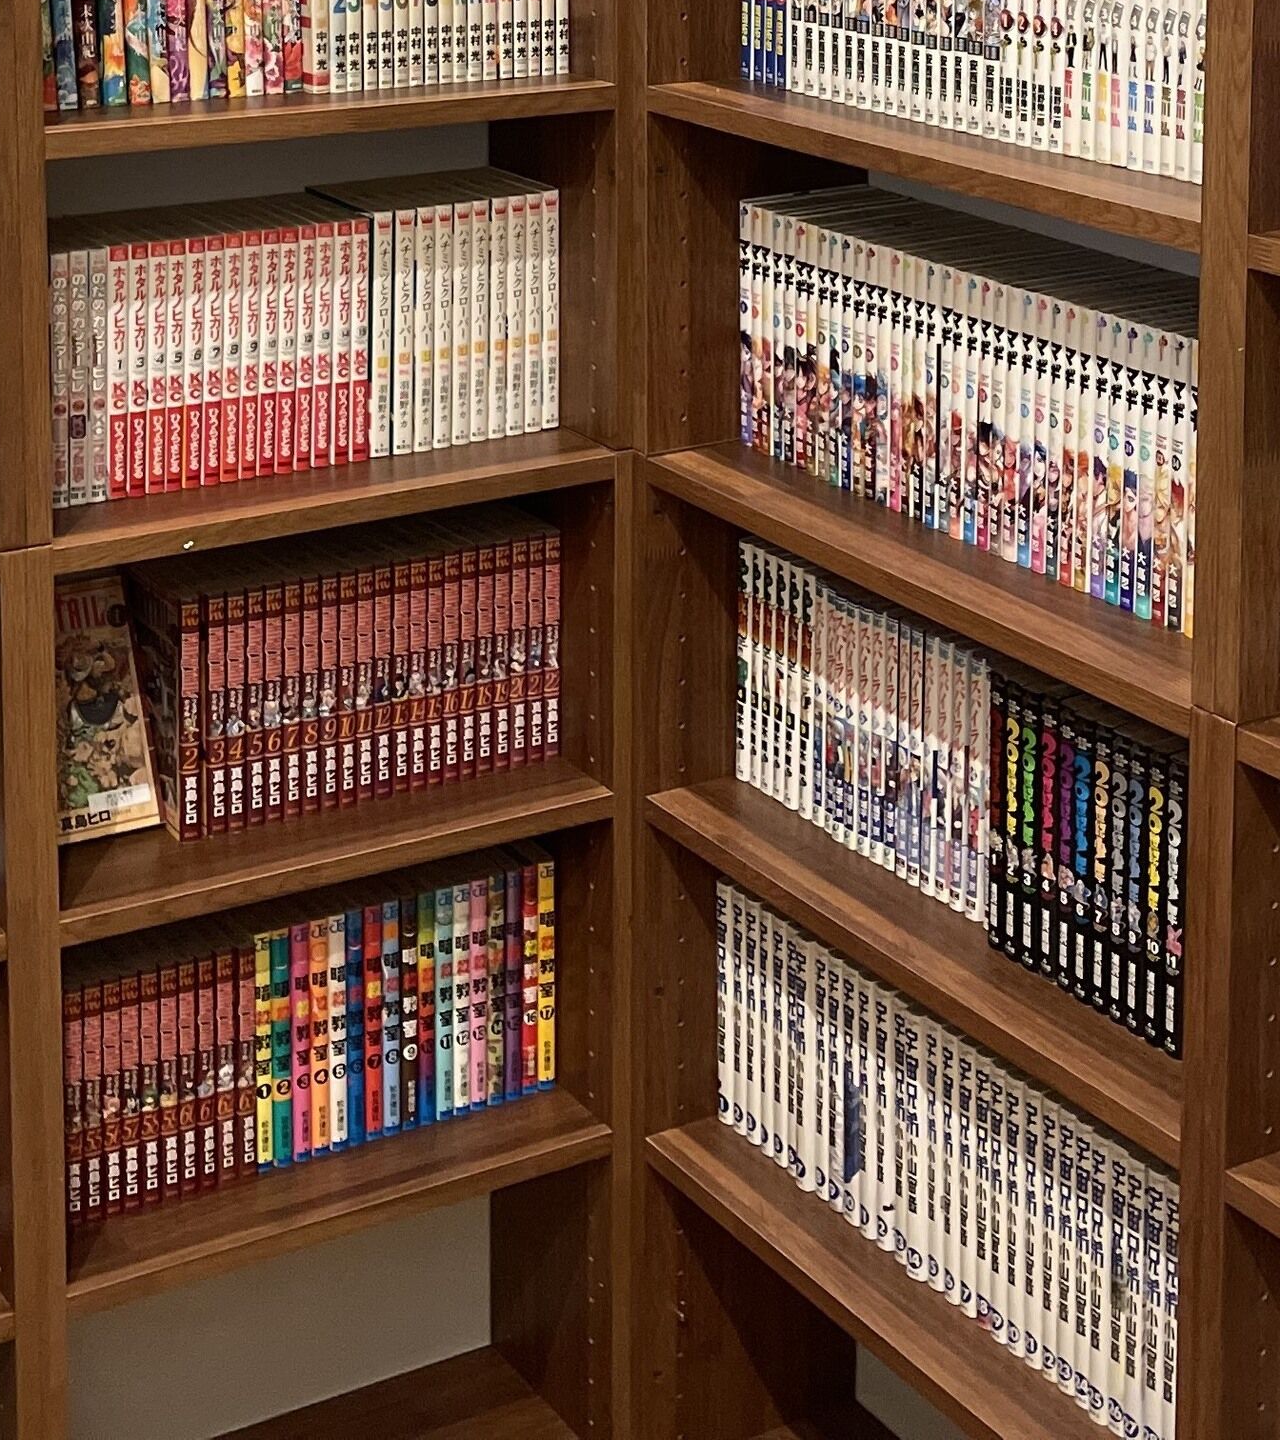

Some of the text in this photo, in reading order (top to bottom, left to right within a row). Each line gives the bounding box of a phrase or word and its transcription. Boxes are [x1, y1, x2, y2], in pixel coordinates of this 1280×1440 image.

[228, 253, 240, 339] ホタルノヒカリ
[377, 239, 390, 351] ハチミツとクローバー
[400, 236, 412, 347] ハチミツとクローバー
[529, 220, 541, 329] ハチミツとクローバー
[113, 266, 126, 354] ホタルノヒカリ
[134, 264, 146, 352] ホタルノヒカリ
[117, 360, 122, 370] 1
[136, 357, 145, 367] 3
[230, 344, 238, 355] 8
[1126, 366, 1139, 411] マギ
[1173, 379, 1186, 425] マギ
[228, 739, 244, 759] 4
[305, 722, 318, 742] 8
[182, 750, 198, 770] 2
